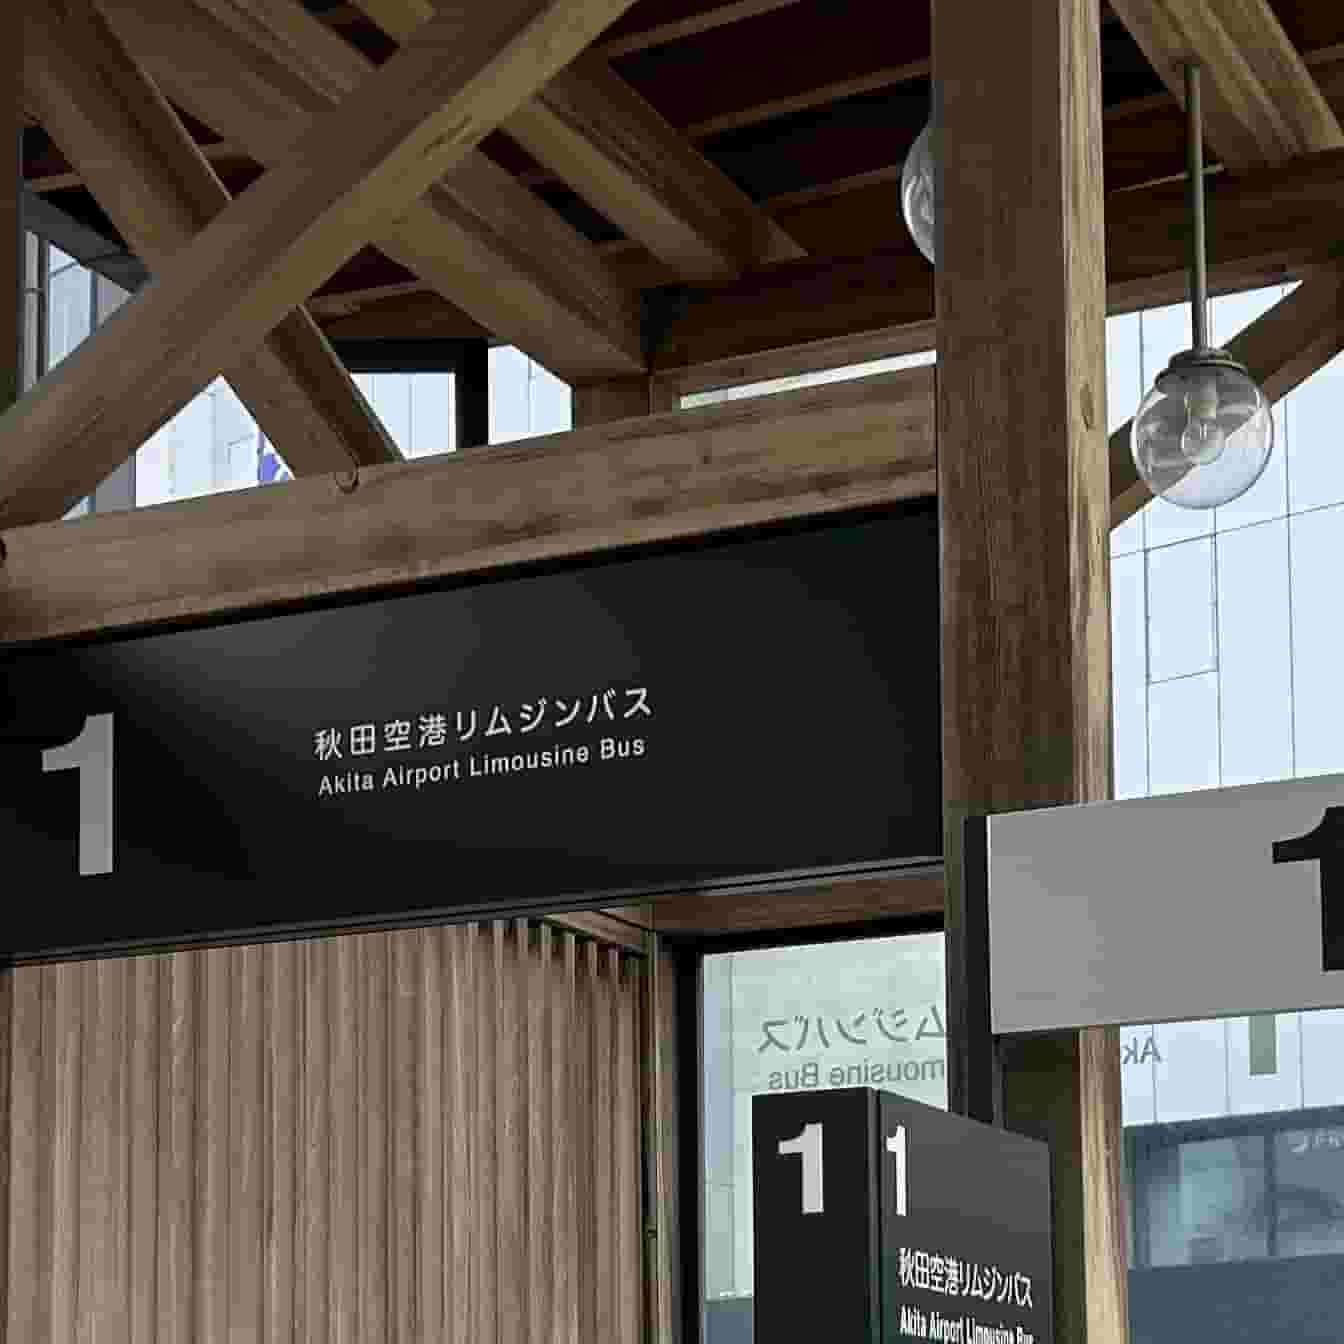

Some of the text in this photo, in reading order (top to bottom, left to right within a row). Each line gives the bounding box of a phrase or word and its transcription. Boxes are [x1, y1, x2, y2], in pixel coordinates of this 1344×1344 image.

[313, 687, 652, 761] 秋田空港リムジンバス
[42, 712, 114, 876] 1
[318, 737, 646, 796] Akita Airport Limousine Bus
[778, 1122, 824, 1215] 1
[886, 1122, 908, 1217] 1
[898, 1247, 1033, 1308] 秋田空港リムジンバス
[900, 1304, 927, 1337] Akita
